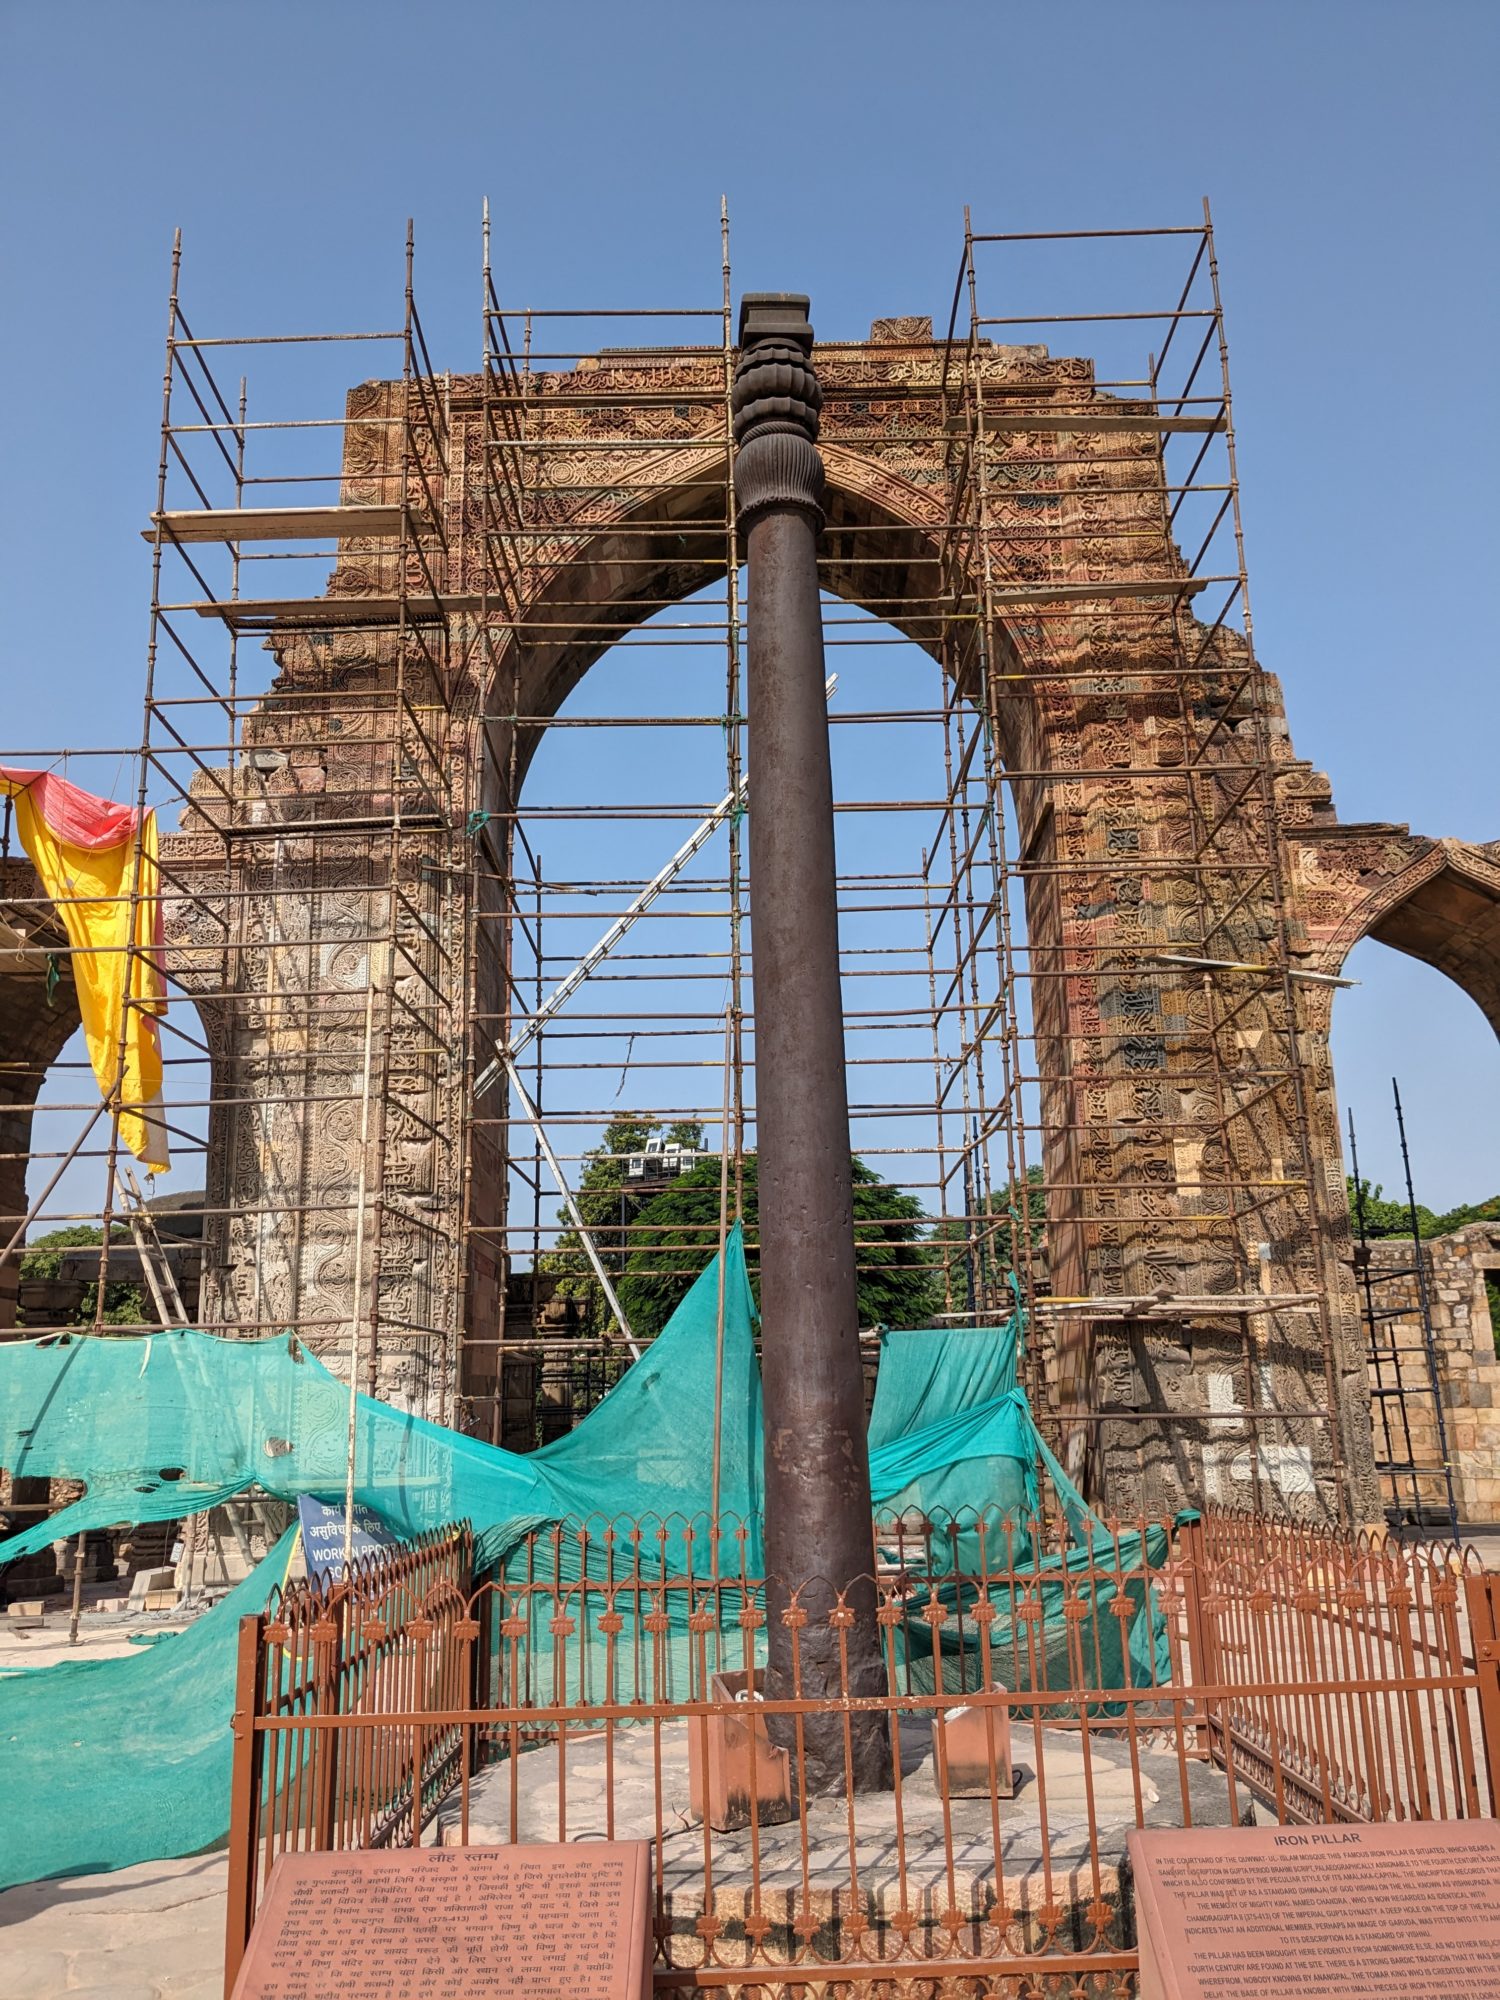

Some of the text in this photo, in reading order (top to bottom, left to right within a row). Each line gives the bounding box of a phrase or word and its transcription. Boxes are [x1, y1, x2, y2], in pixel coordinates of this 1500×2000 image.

[313, 1546, 345, 1562] WORK
[1274, 1832, 1362, 1847] IRON PILLAR
[463, 1853, 499, 1861] स्तम्भ
[1300, 1934, 1344, 1942] DESCRIPTION
[1264, 1949, 1297, 1957] BROUGHT
[1455, 1940, 1478, 1948] OTHER
[1260, 1962, 1284, 1970] FOUND
[1389, 1956, 1415, 1964] BARDIC
[1431, 1967, 1465, 1975] CREDITED
